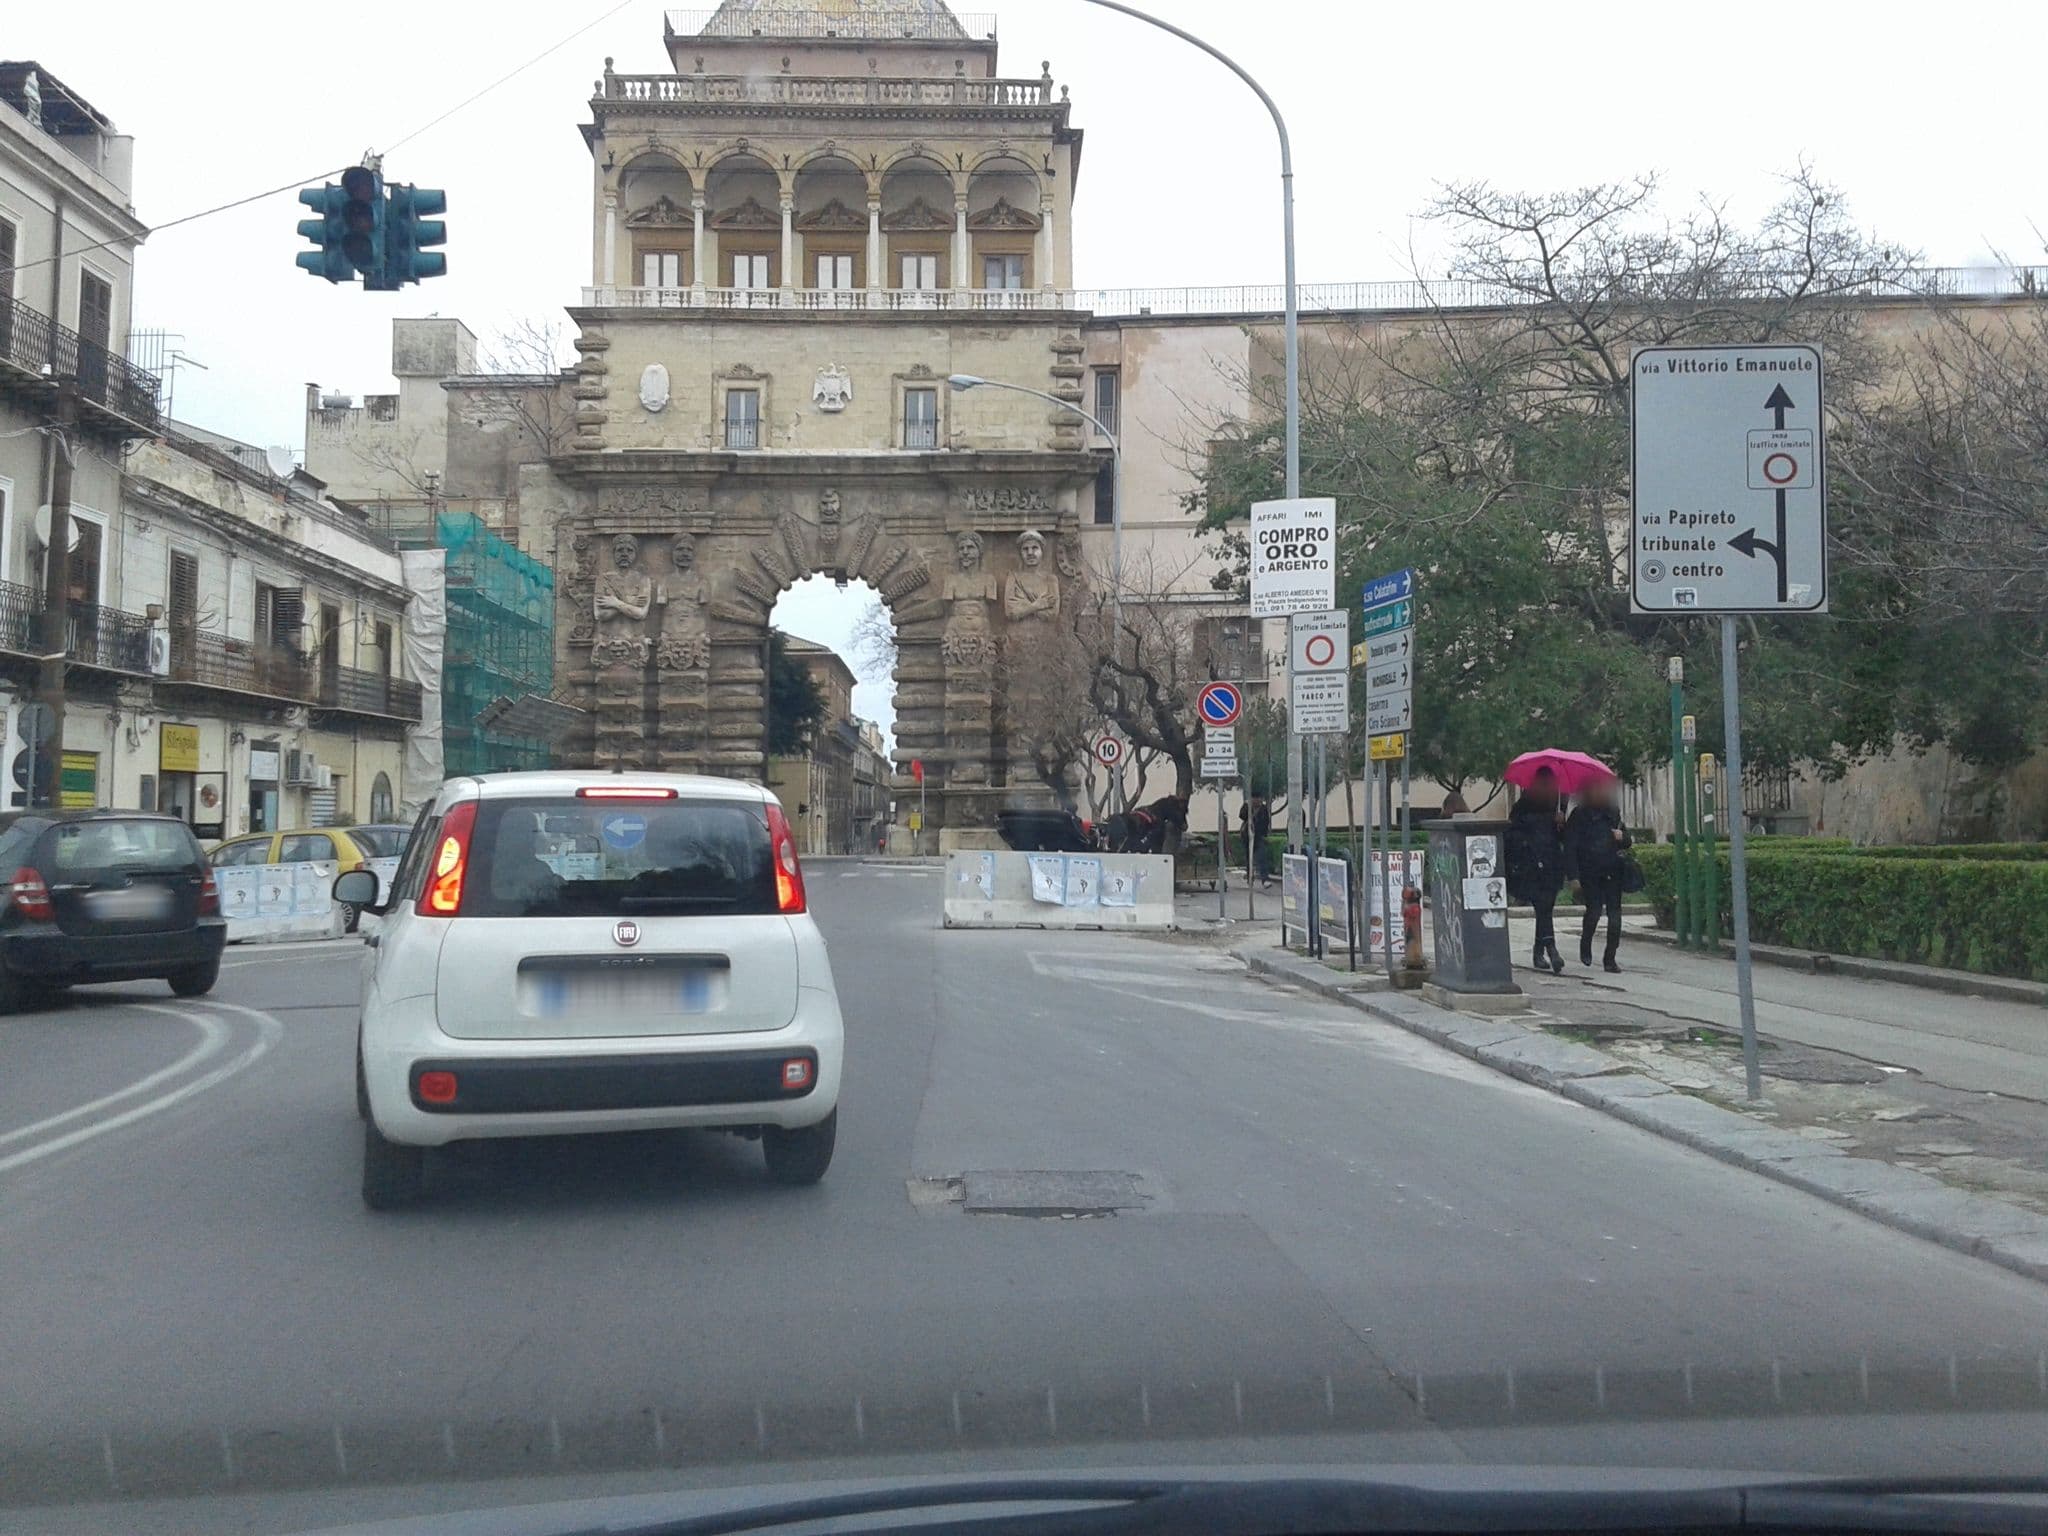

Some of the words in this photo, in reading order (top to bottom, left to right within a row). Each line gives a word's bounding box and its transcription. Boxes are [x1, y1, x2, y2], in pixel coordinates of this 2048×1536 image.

[1641, 363, 1660, 374] via
[1667, 358, 1729, 374] Vittorio
[1736, 356, 1813, 372] Emanuele
[1771, 432, 1788, 440] zona
[1750, 440, 1778, 449] traffico
[1780, 440, 1811, 449] limitato
[1256, 512, 1287, 522] AFFARI
[1304, 511, 1322, 519] IMI
[1642, 512, 1661, 525] via
[1668, 509, 1736, 529] Papireto
[1259, 526, 1329, 545] COMPRO
[1641, 535, 1717, 551] tribunale
[1265, 543, 1318, 560] ORO
[1258, 565, 1265, 574] e
[1268, 559, 1329, 573] ARGENTO
[1672, 561, 1724, 577] centro
[1264, 590, 1289, 598] ALBERTO
[1102, 743, 1115, 758] 10
[619, 926, 635, 939] FIAT
